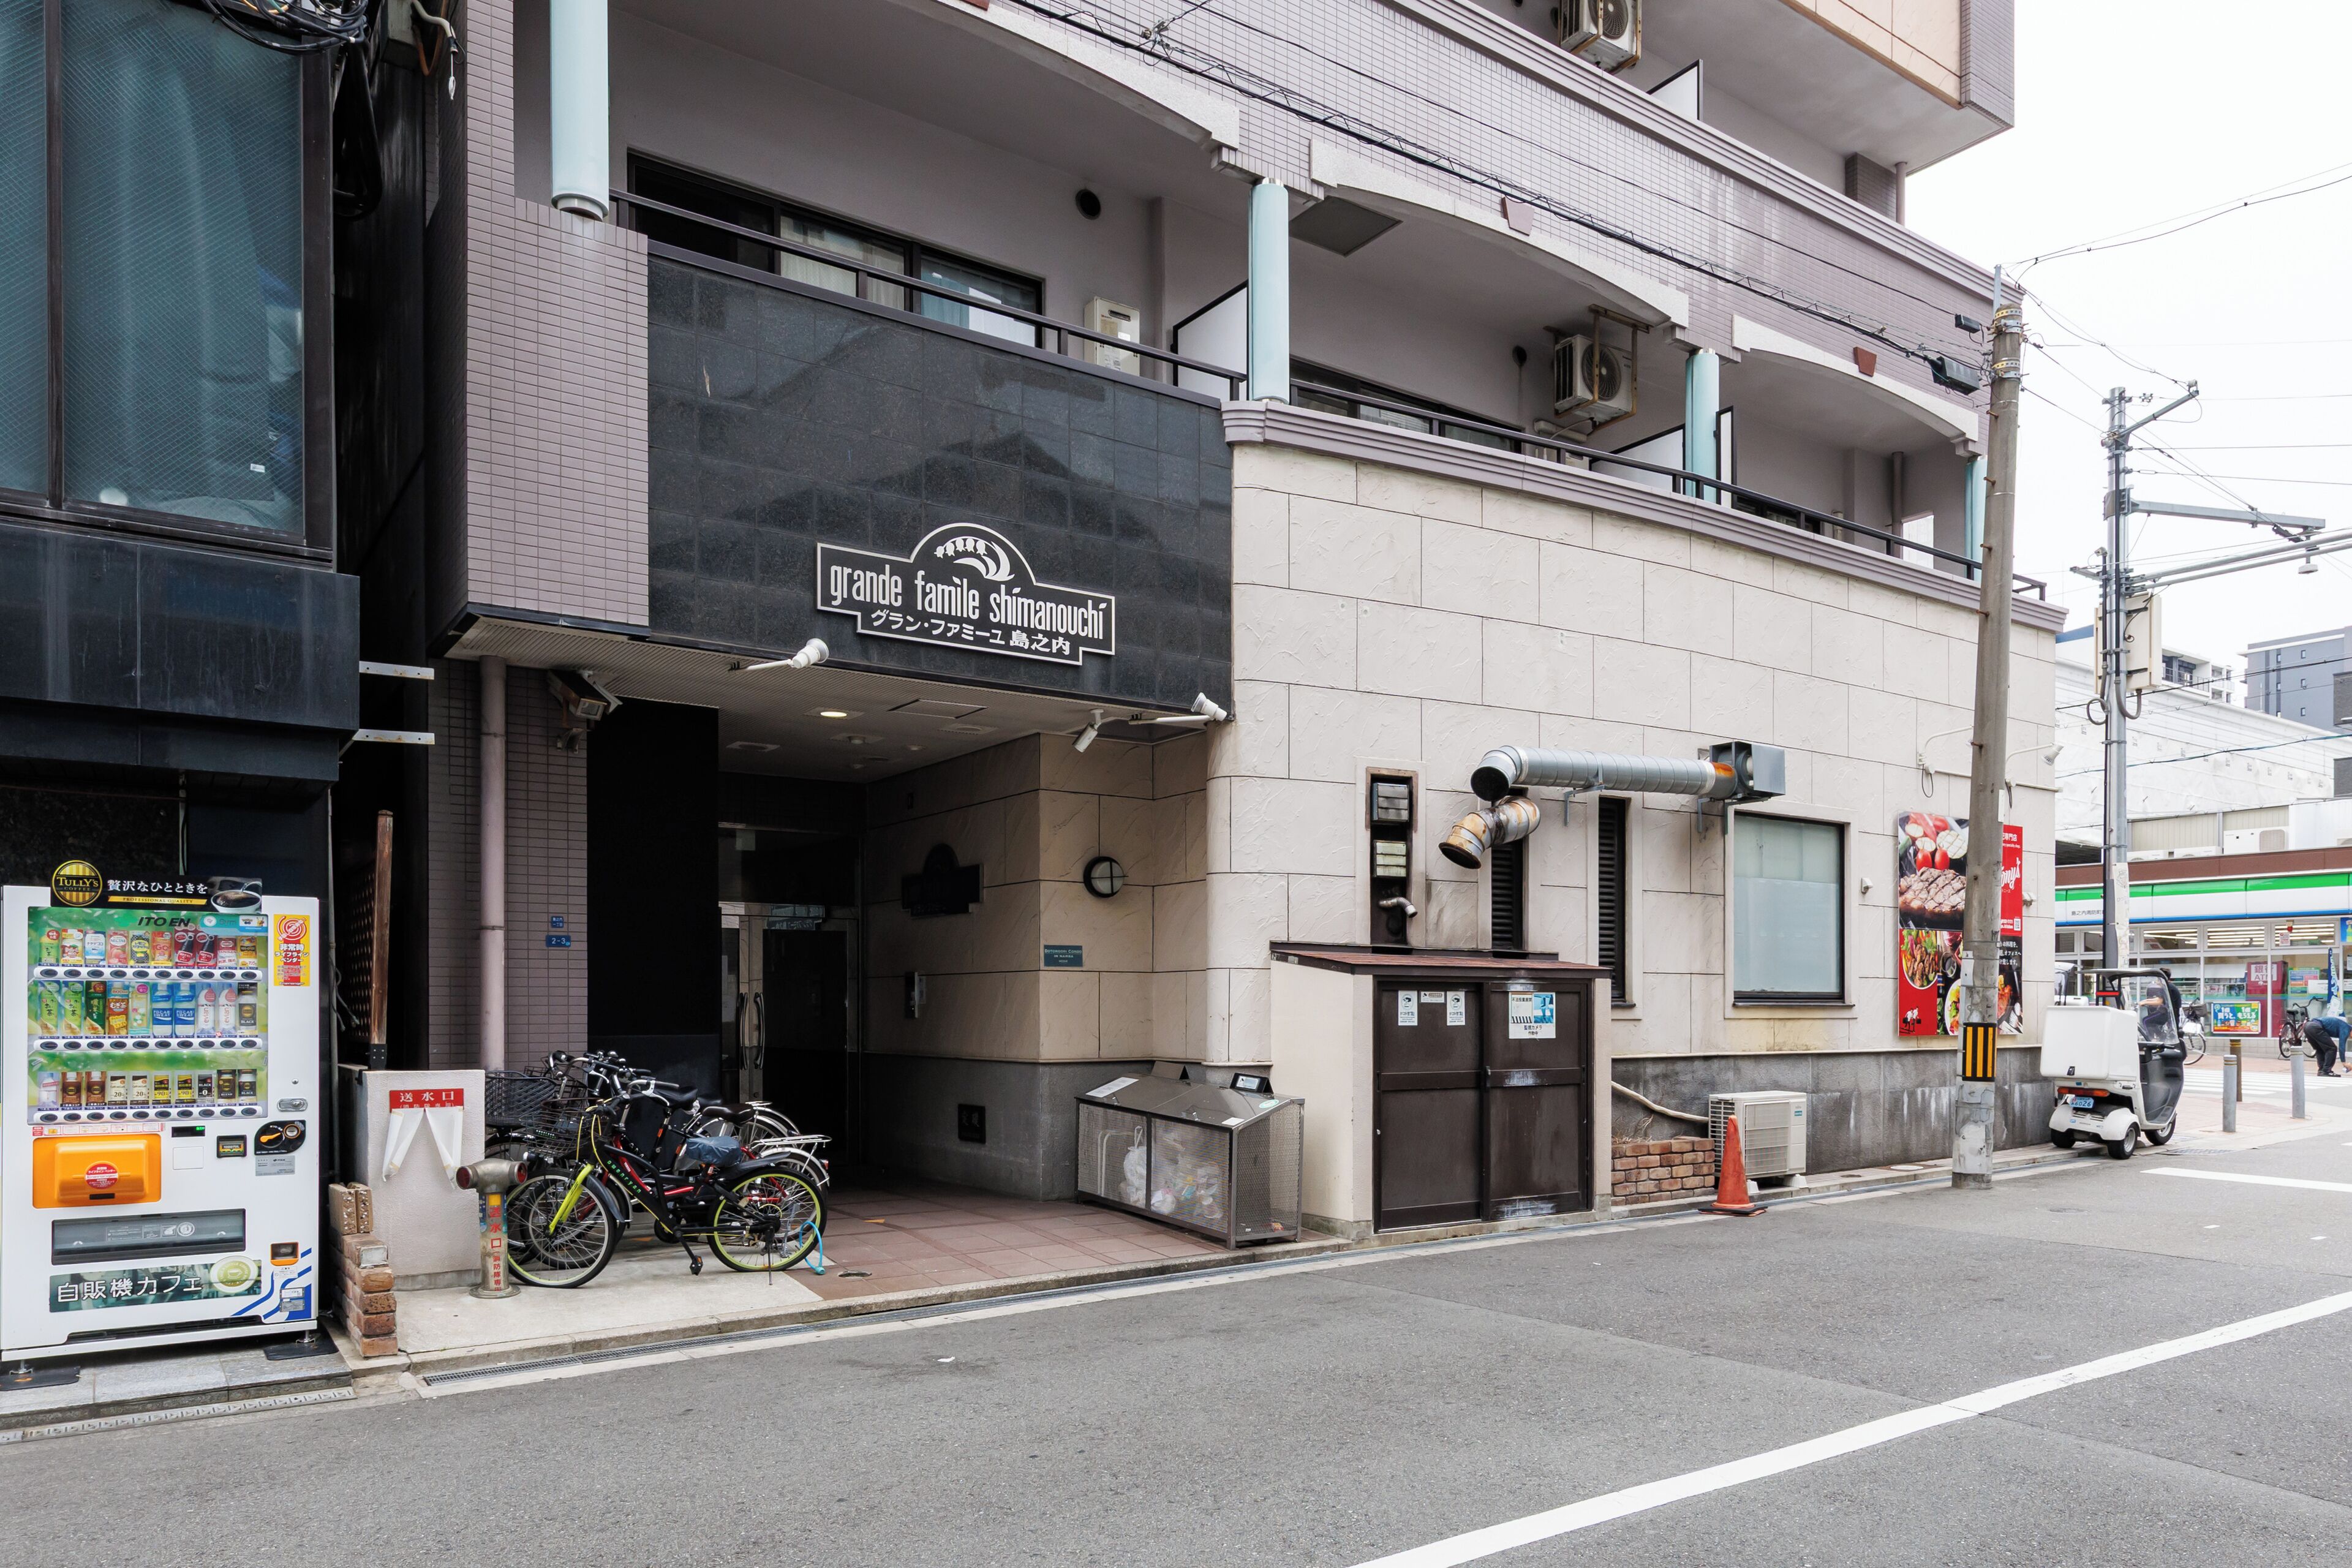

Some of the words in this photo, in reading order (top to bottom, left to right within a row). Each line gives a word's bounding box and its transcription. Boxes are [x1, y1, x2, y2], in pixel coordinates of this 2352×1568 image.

[830, 564, 902, 606] grande
[914, 570, 980, 620] famile
[989, 584, 1108, 640] shimanouchi
[871, 609, 1005, 645] グラン・ファミーユ
[1009, 630, 1071, 655] 島之内
[56, 876, 99, 888] TULLY'S
[107, 879, 208, 894] 贅沢なひとときを
[138, 916, 167, 927] ITO
[168, 918, 191, 927] EN
[399, 1091, 454, 1102] 送水口
[489, 1205, 502, 1249] 送水口
[57, 1274, 203, 1303] 自販機カフェ
